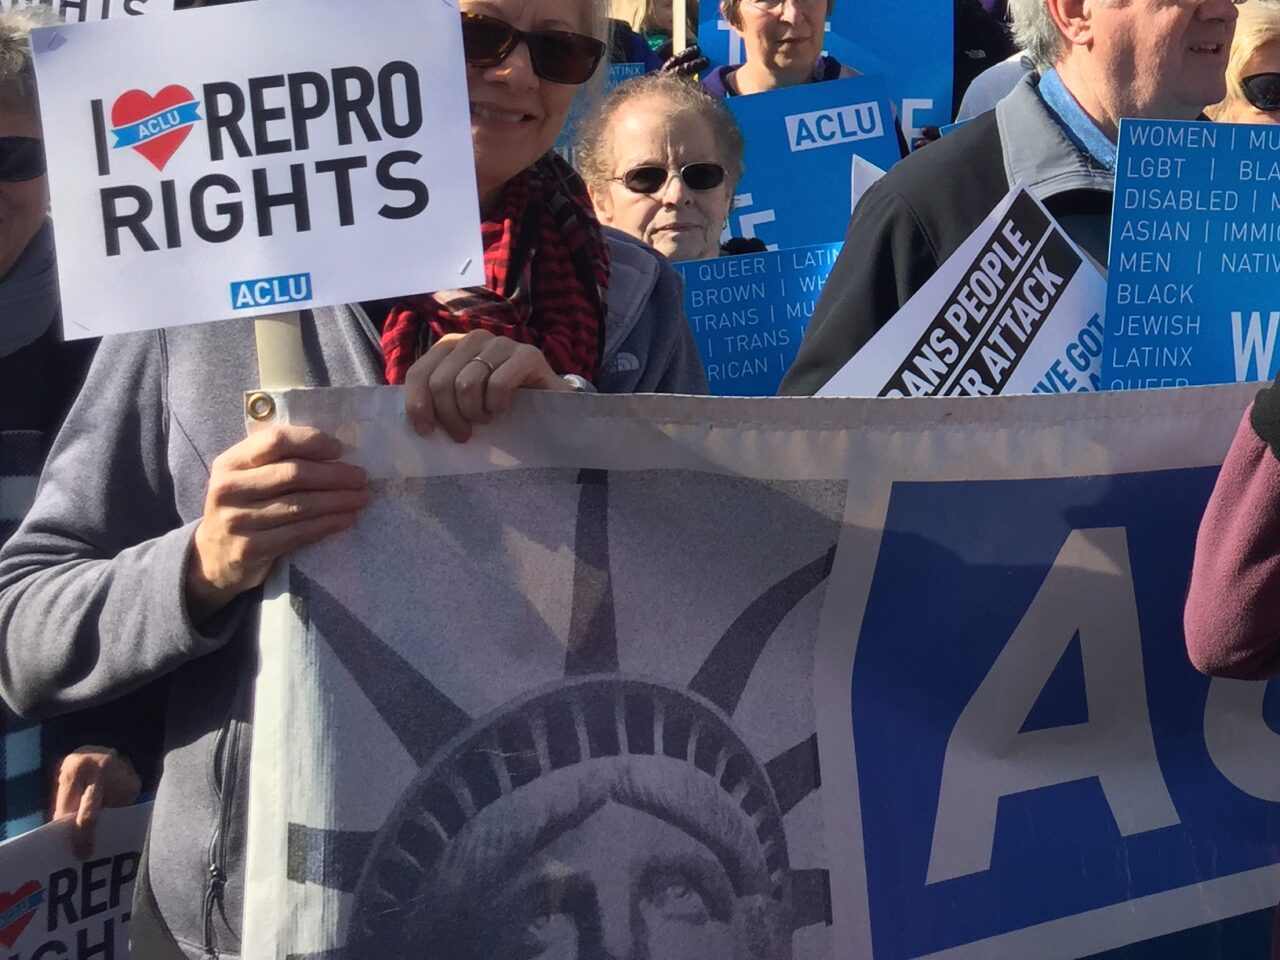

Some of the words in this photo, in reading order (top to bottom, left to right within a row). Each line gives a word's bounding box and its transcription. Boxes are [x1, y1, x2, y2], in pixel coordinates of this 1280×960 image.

[609, 67, 640, 75] ATINX
[90, 99, 110, 176] I
[202, 60, 423, 162] REPRO
[137, 110, 180, 140] ACLU
[795, 106, 876, 146] ACLU
[1129, 126, 1216, 148] WOMEN
[1127, 158, 1186, 178] LGBT
[100, 150, 429, 256] RIGHTS
[1125, 189, 1238, 210] DISABLED
[1120, 221, 1190, 241] ASIAN
[699, 258, 767, 280] QUEER
[1119, 252, 1171, 272] MEN
[236, 277, 308, 307] ACLU
[692, 283, 765, 308] BROWN
[1117, 284, 1194, 304] BLACK
[885, 327, 960, 398] ANS
[944, 219, 1032, 342] PEOPLE
[980, 255, 1064, 384] ATTACK
[692, 309, 759, 332] TRANS
[1113, 315, 1200, 336] JEWISH
[724, 329, 790, 352] TRANS
[1066, 312, 1104, 372] GOT
[1113, 346, 1192, 368] LATINX
[707, 357, 768, 381] RICAN
[47, 851, 142, 932] REP
